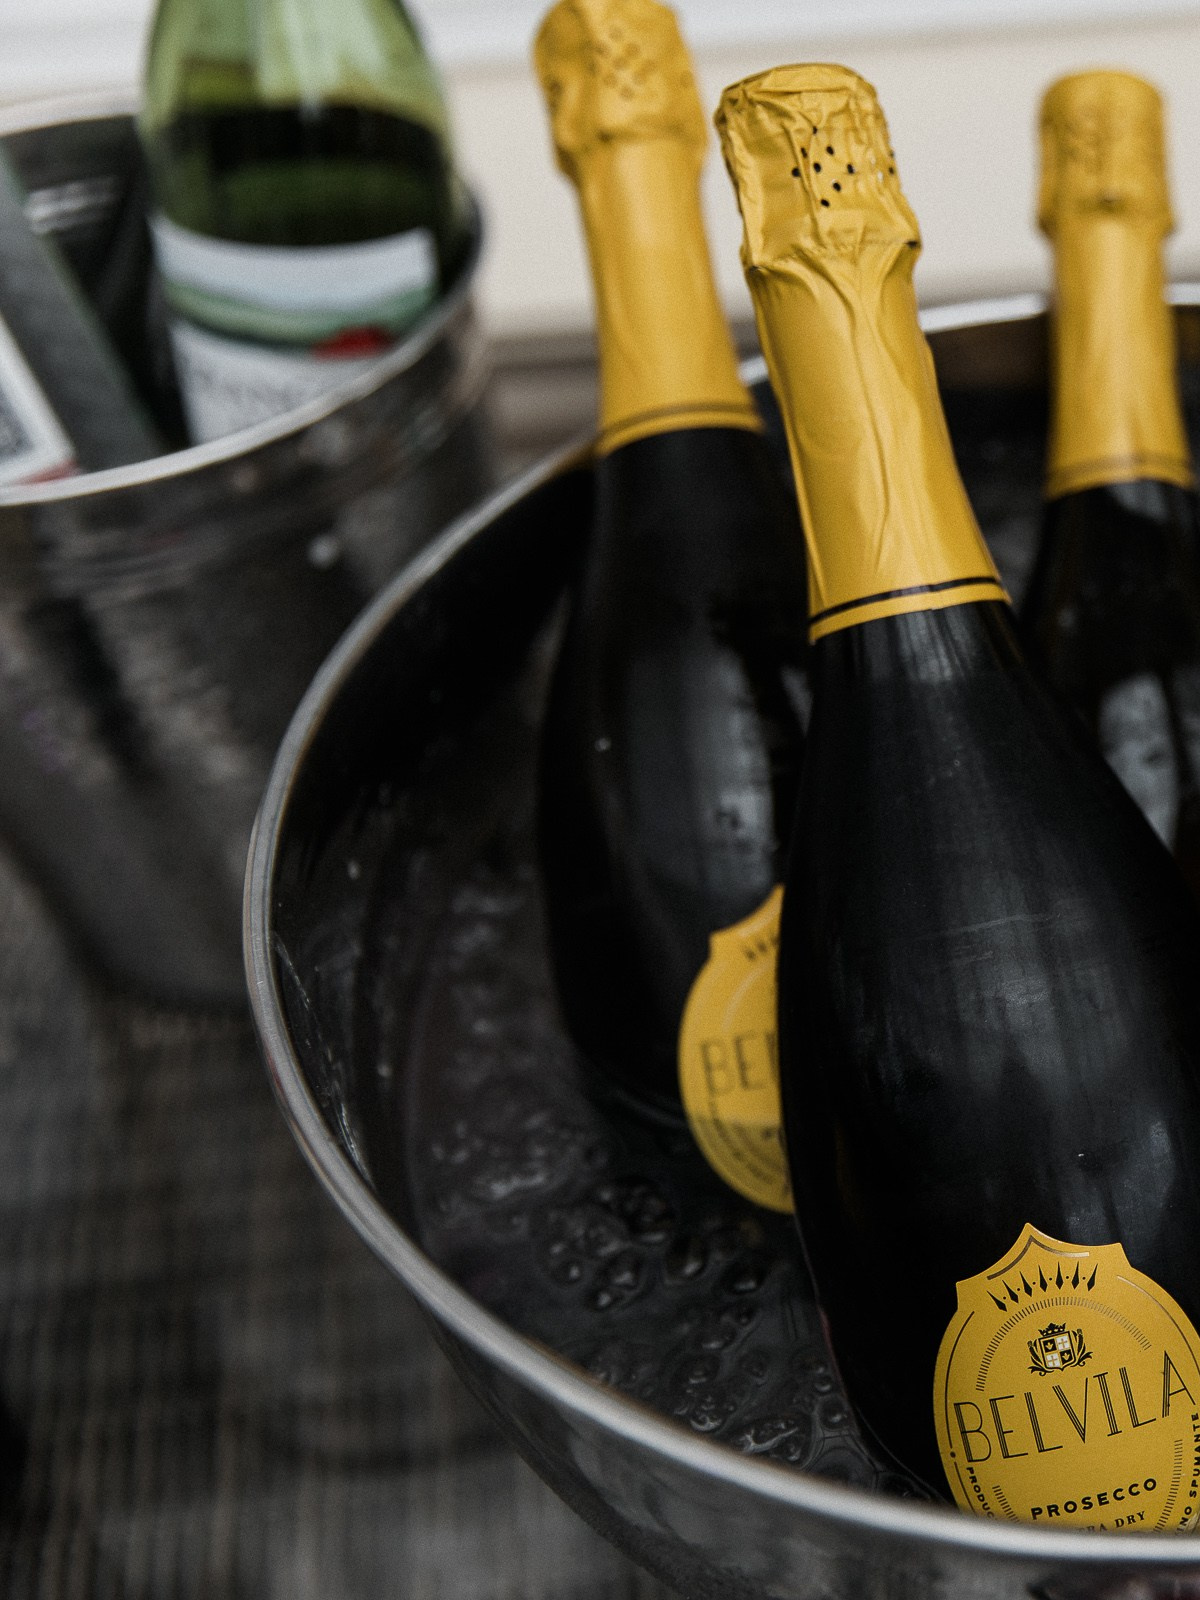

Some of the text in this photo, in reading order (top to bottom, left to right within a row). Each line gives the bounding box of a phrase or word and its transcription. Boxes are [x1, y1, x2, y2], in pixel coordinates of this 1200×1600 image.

[953, 1350, 1196, 1463] BELVILA
[966, 1467, 997, 1520] PRODUC
[1031, 1478, 1157, 1520] PROSECCO
[1115, 1511, 1145, 1528] DRY
